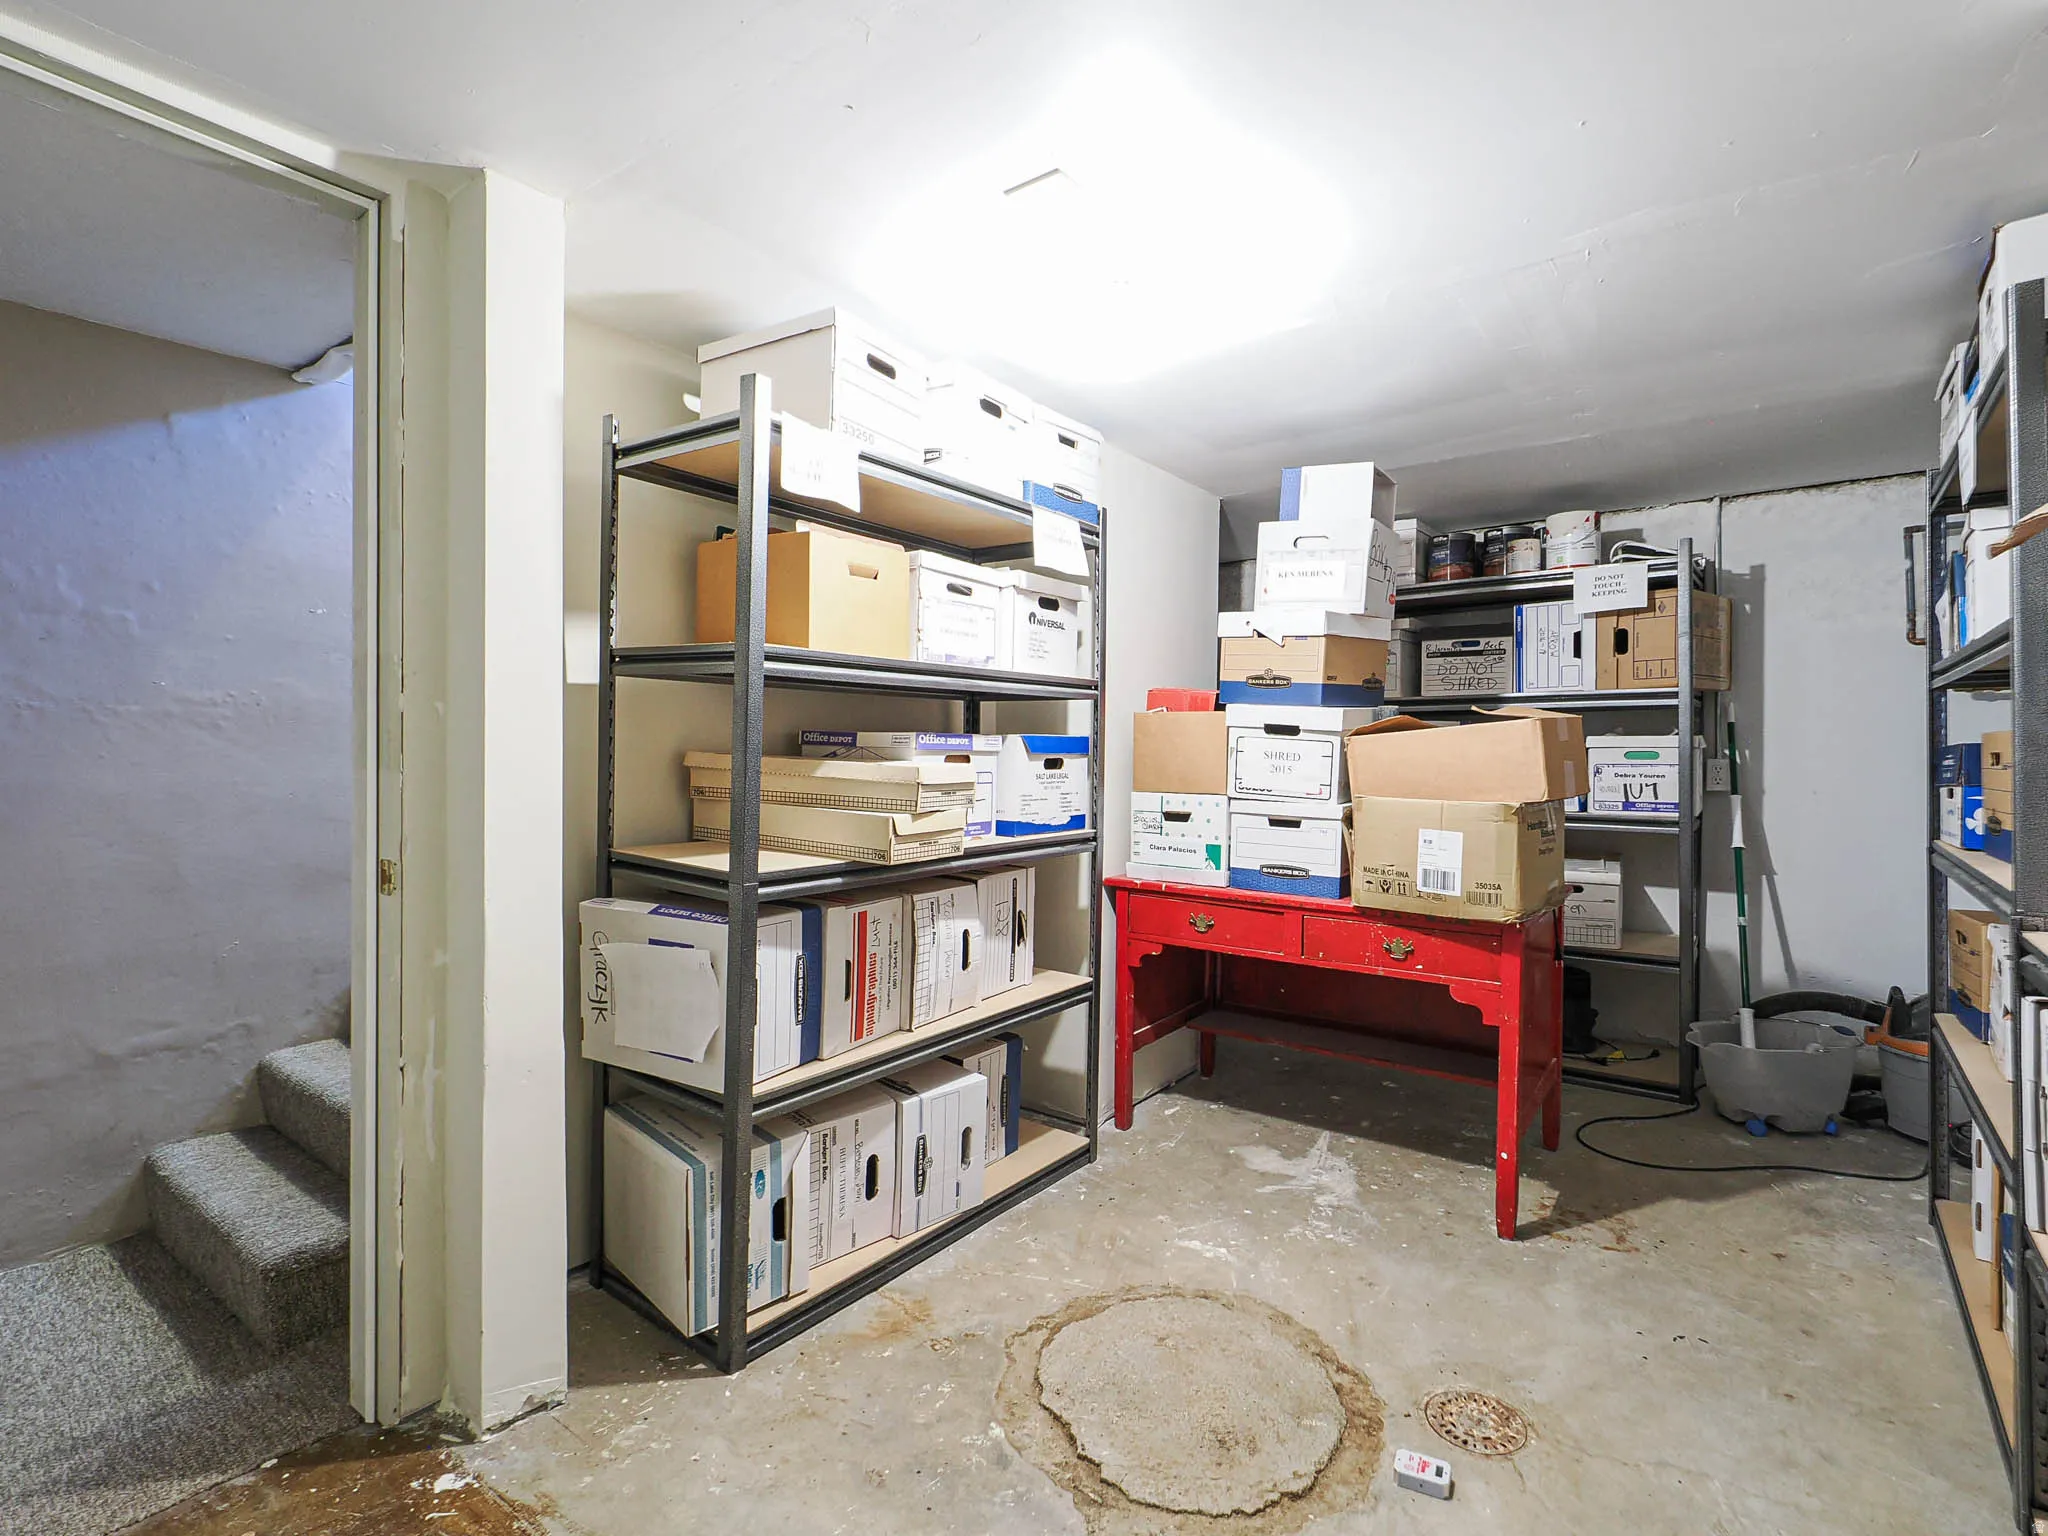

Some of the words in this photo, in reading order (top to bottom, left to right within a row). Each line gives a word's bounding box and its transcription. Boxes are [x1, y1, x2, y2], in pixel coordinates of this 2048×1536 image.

[1591, 588, 1628, 597] KEEPING
[1437, 664, 1459, 676] DO
[1465, 661, 1494, 676] NOT
[1440, 675, 1498, 691] SHRED
[803, 732, 829, 742] Office
[829, 735, 853, 744] DEPOT
[918, 734, 946, 745] Office
[946, 737, 970, 745] DEPOT
[1263, 750, 1302, 763] SHRED
[1269, 763, 1293, 775] 2015
[1168, 845, 1197, 854] Palacios
[873, 852, 886, 861] 706
[1261, 866, 1291, 876] BANKERS
[1362, 866, 1380, 874] MADE
[1474, 882, 1503, 891] 35035A
[657, 907, 690, 916] DEPOT
[691, 911, 728, 923] Office
[866, 952, 878, 1037] alphagraphics
[822, 1133, 830, 1168] Bankers
[917, 1138, 925, 1174] BANKERS
